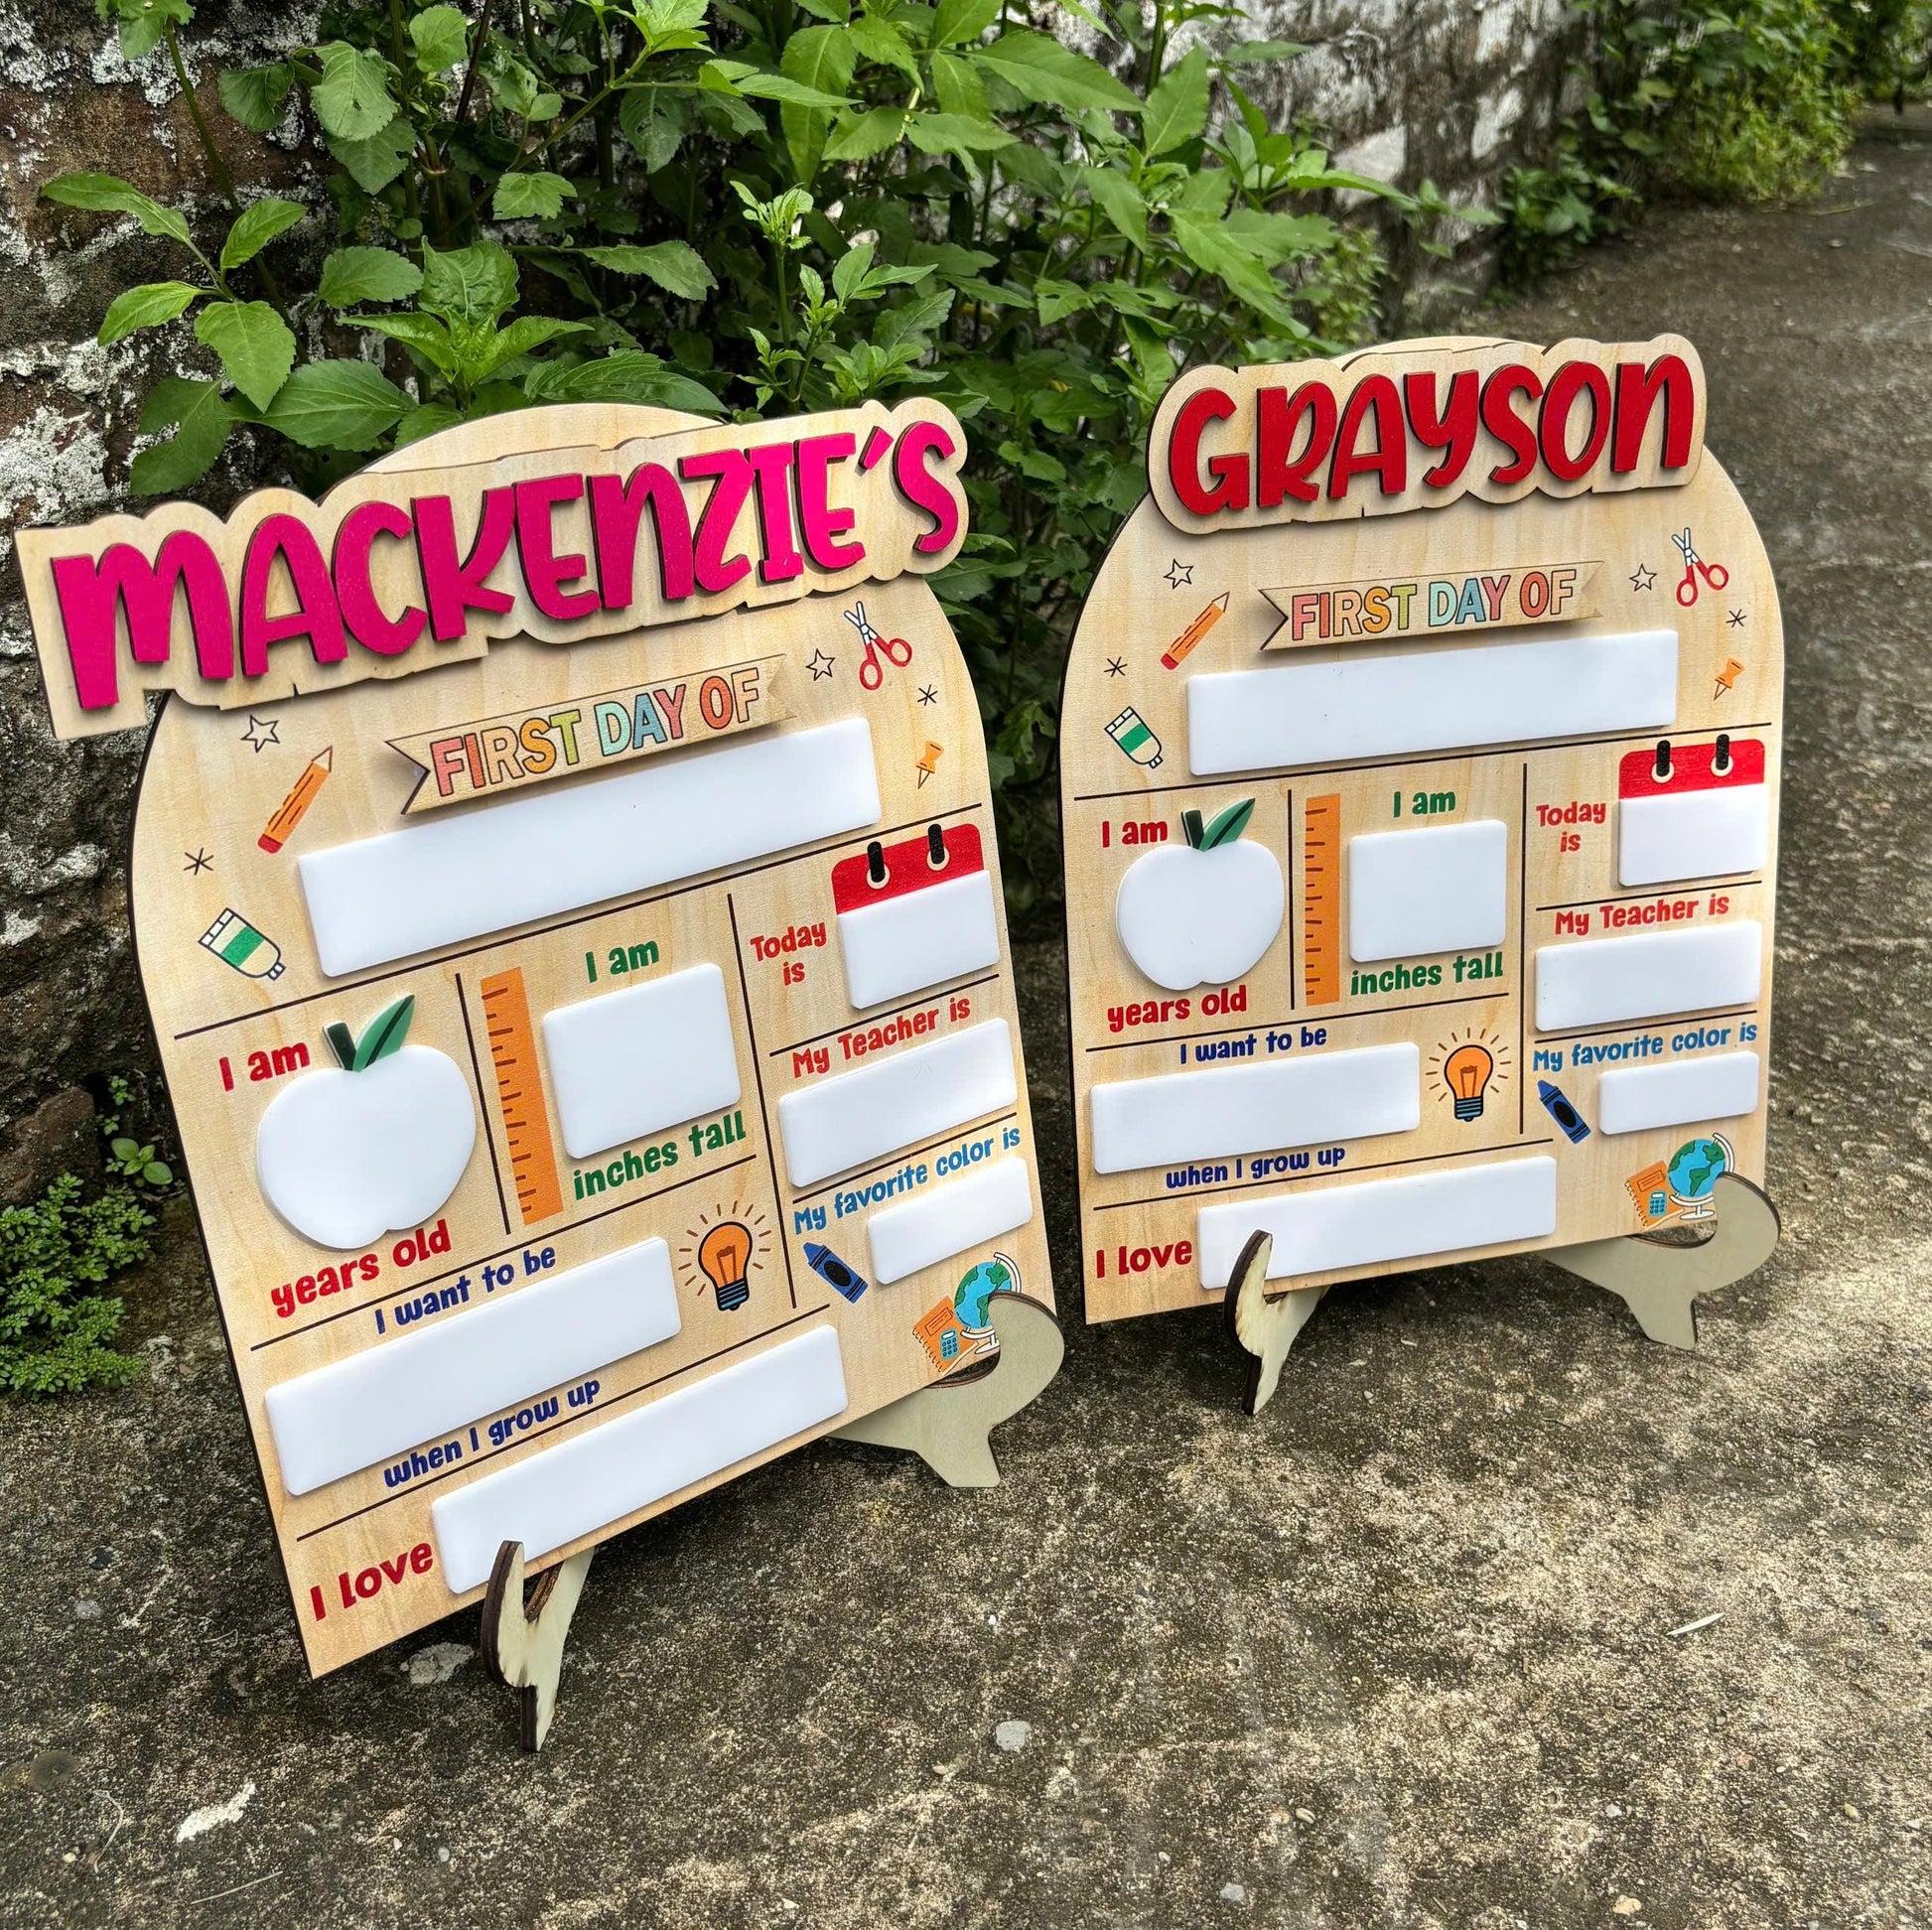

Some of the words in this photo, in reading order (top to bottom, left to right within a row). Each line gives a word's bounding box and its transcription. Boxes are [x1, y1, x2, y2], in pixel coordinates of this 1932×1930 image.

[1169, 353, 1696, 515] GRAYSON
[51, 419, 959, 711] MACKENZIE'S
[1291, 585, 1417, 639] FIRST
[1429, 575, 1511, 627] DAY
[1521, 568, 1577, 617] OF
[429, 709, 581, 796] FIRST
[597, 683, 688, 758] DAY
[698, 665, 760, 731] OF
[1394, 793, 1401, 817] I
[1412, 792, 1455, 815] am
[1537, 803, 1606, 826] Today
[1102, 821, 1110, 849] I
[1121, 821, 1169, 846] am
[1560, 831, 1581, 853] is
[1555, 911, 1590, 936] My
[1599, 900, 1699, 927] Teacher
[1708, 894, 1729, 915] is
[584, 950, 598, 983] I
[609, 941, 658, 975] am
[751, 921, 827, 963] Today
[783, 962, 804, 984] is
[1351, 965, 1442, 996] inches
[1453, 952, 1502, 983] tall
[1108, 999, 1190, 1034] years
[1200, 985, 1247, 1017] old
[793, 1047, 831, 1078] My
[839, 1011, 938, 1060] Teacher
[949, 1000, 969, 1022] is
[1180, 1044, 1186, 1064] I
[1195, 1034, 1257, 1062] want
[1266, 1033, 1293, 1053] to
[1301, 1027, 1326, 1047] be
[1533, 1051, 1563, 1072] My
[1572, 1036, 1663, 1066] favorite
[1672, 1029, 1729, 1052] color
[1738, 1022, 1757, 1042] is
[218, 1057, 234, 1092] I
[247, 1042, 311, 1082] am
[574, 1143, 678, 1200] inches
[688, 1110, 747, 1158] tall
[1166, 1166, 1228, 1188] when
[1236, 1160, 1242, 1178] I
[1250, 1154, 1310, 1179] grow
[1317, 1148, 1345, 1167] up
[793, 1205, 828, 1236] My
[834, 1166, 926, 1218] favorite
[936, 1140, 993, 1176] color
[1002, 1127, 1021, 1150] is
[271, 1254, 379, 1318] years
[392, 1219, 451, 1268] old
[1096, 1251, 1105, 1278] I
[1118, 1241, 1192, 1275] love
[375, 1310, 385, 1334] I
[394, 1278, 472, 1327] want
[482, 1265, 514, 1292] to
[523, 1248, 555, 1276] be
[384, 1442, 462, 1487] when
[470, 1428, 480, 1451] I
[488, 1397, 560, 1448] grow
[567, 1378, 602, 1409] up
[311, 1586, 325, 1621] I
[339, 1543, 433, 1608] love
